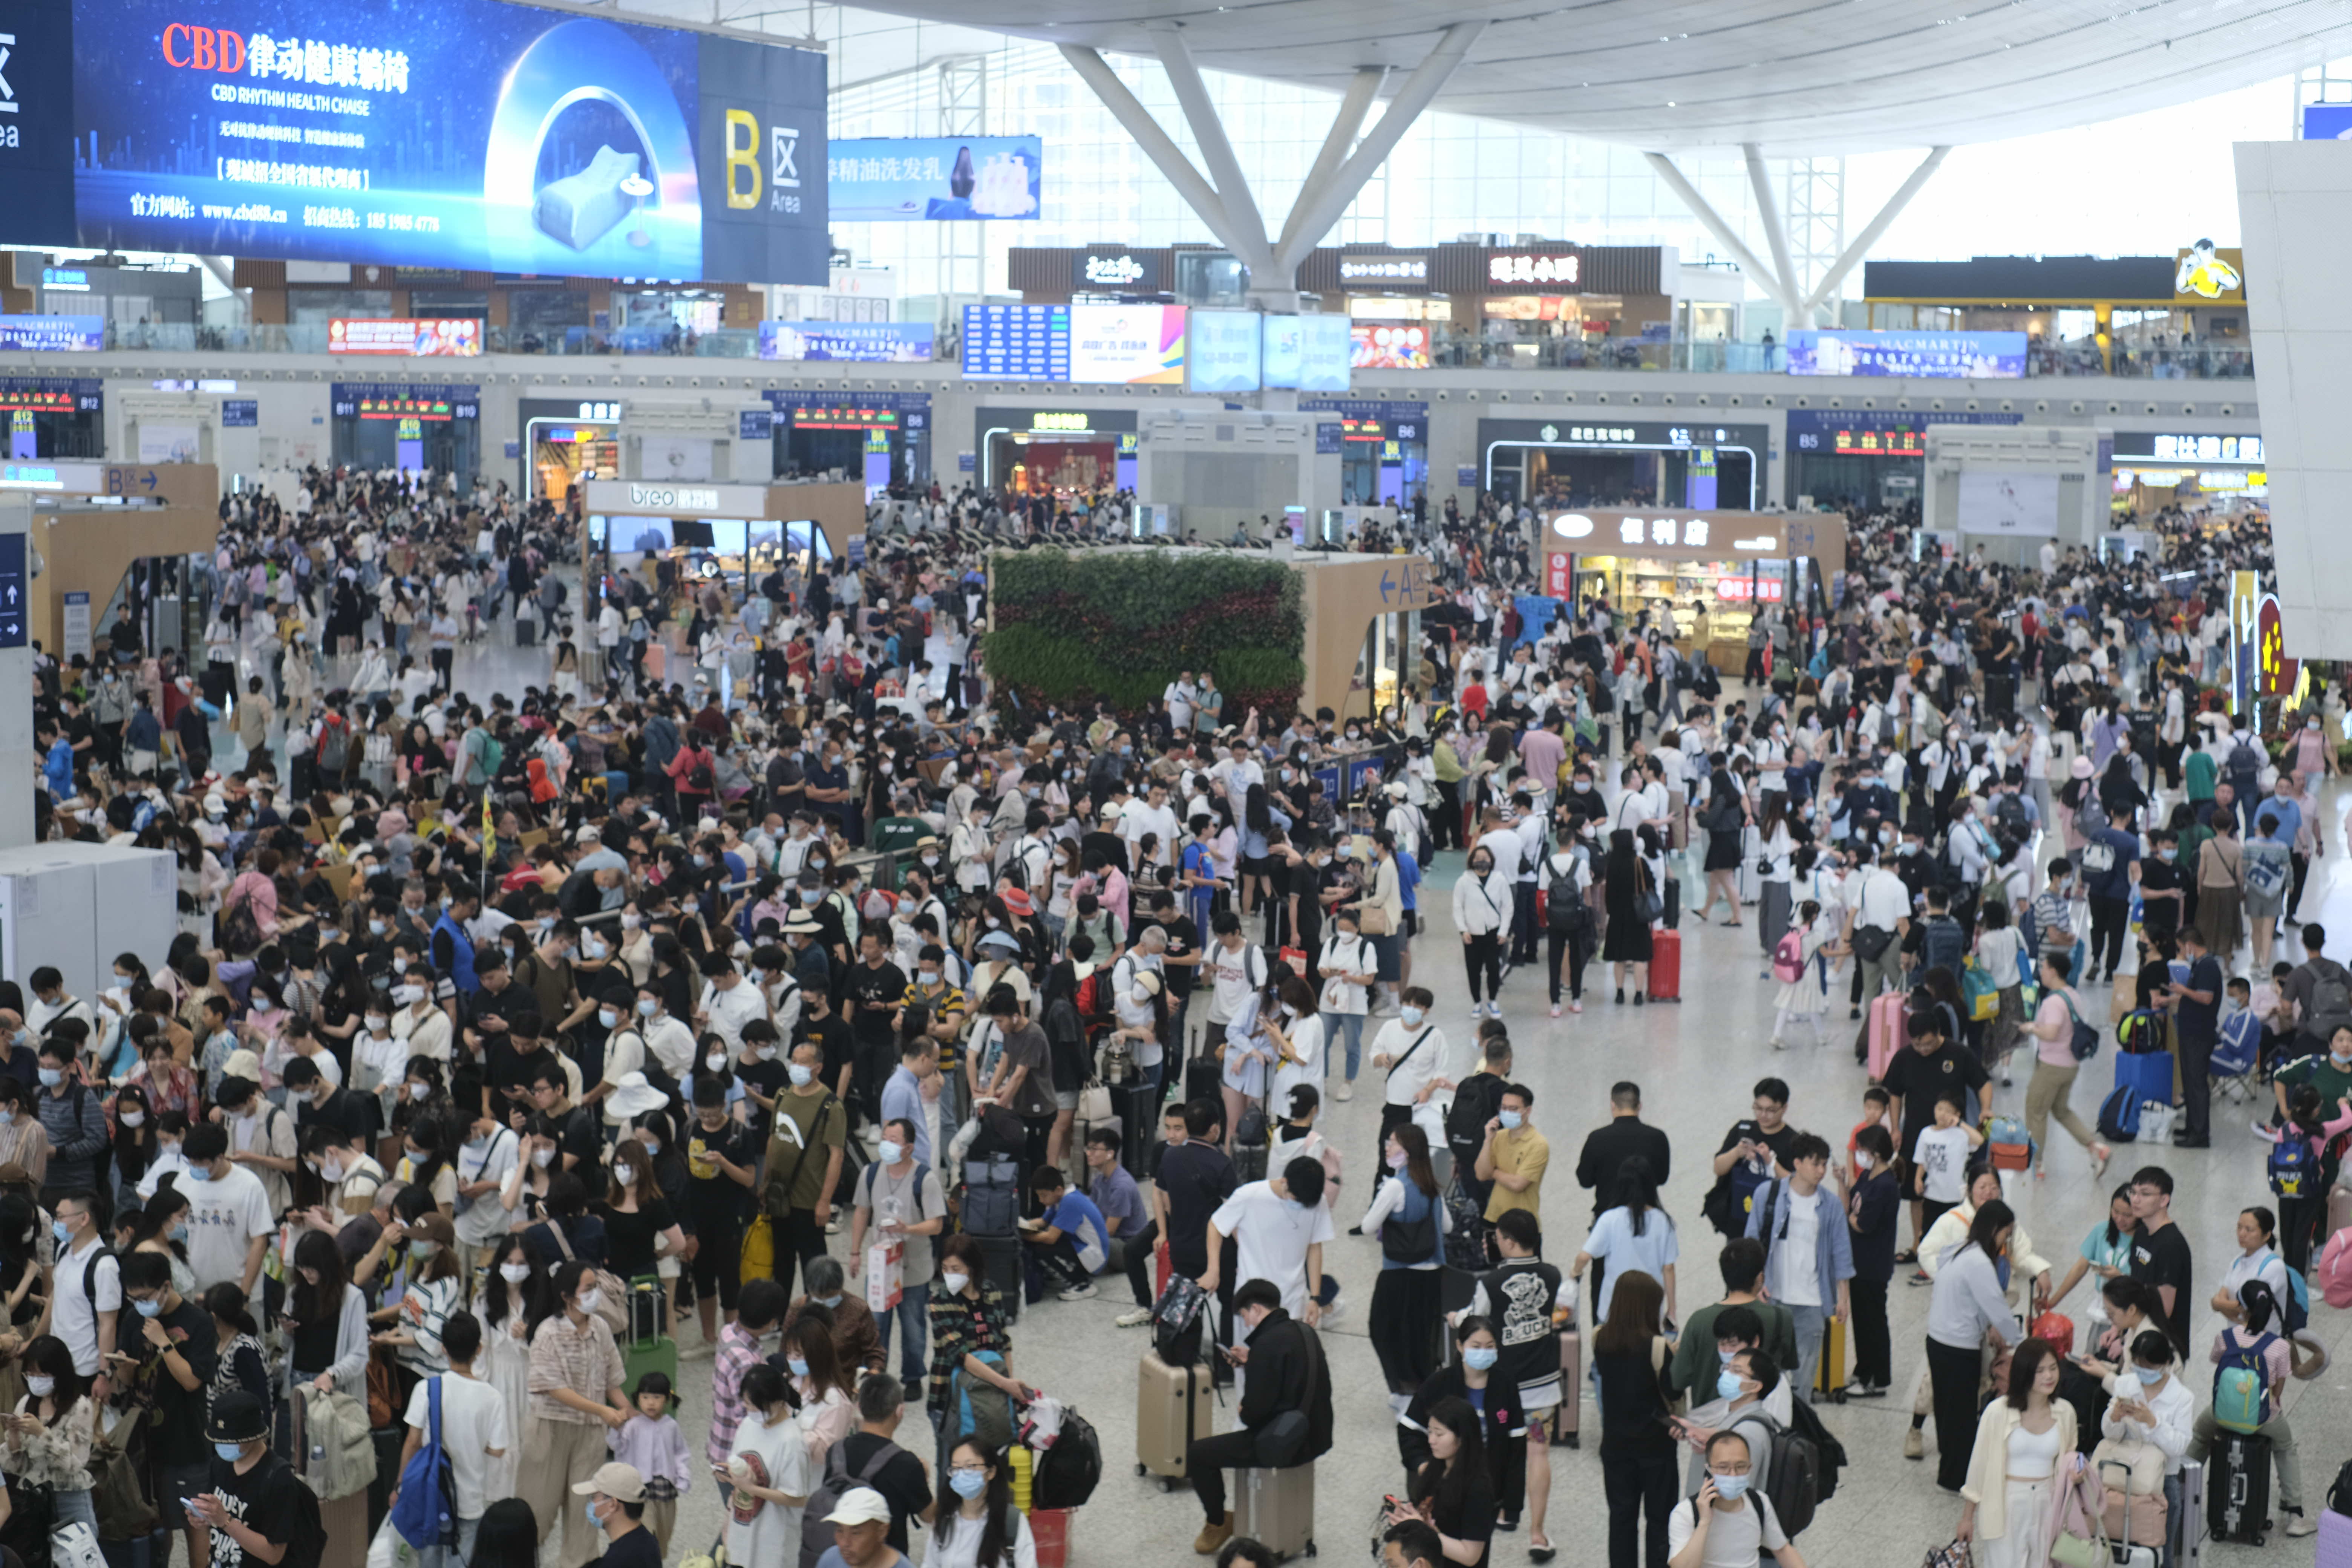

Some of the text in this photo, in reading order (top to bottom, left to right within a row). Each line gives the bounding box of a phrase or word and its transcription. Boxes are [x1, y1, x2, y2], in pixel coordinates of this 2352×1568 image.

[162, 23, 245, 73] CBD
[211, 83, 370, 116] CBD RHYTHM HEALTH CHAISE
[725, 109, 800, 210] B 区
[770, 190, 800, 213] Area
[1398, 424, 1415, 438] B6
[1799, 433, 1819, 449] B5
[109, 469, 123, 495] B
[631, 485, 674, 507] breo
[1399, 563, 1413, 605] A
